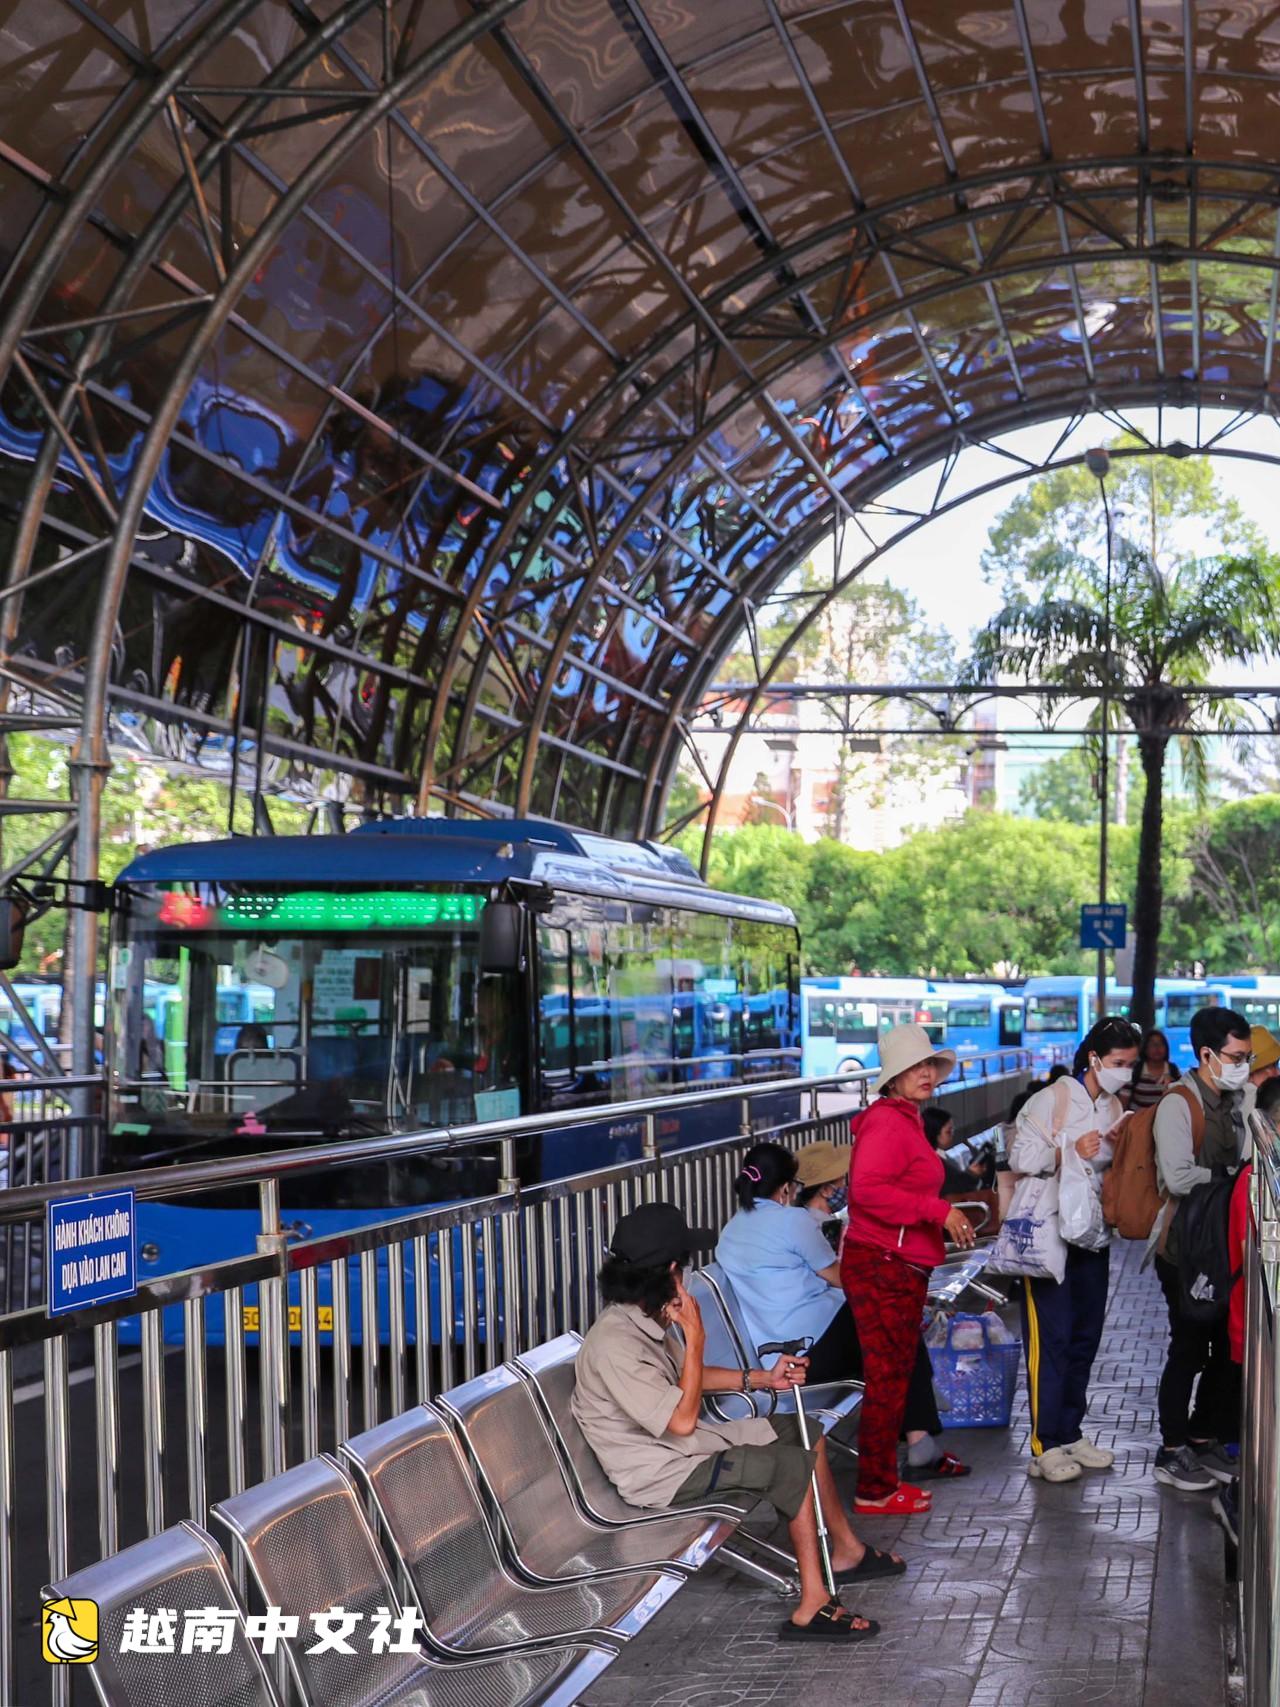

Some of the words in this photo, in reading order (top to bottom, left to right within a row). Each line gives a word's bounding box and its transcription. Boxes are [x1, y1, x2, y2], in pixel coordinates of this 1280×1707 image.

[55, 1219, 77, 1251] HÀNH
[78, 1213, 104, 1246] KHÁCH
[105, 1209, 129, 1240] KHÔNG
[62, 1261, 79, 1295] DỰA
[79, 1255, 94, 1286] VÀO
[95, 1255, 110, 1282] LAN
[111, 1251, 126, 1278] CAN
